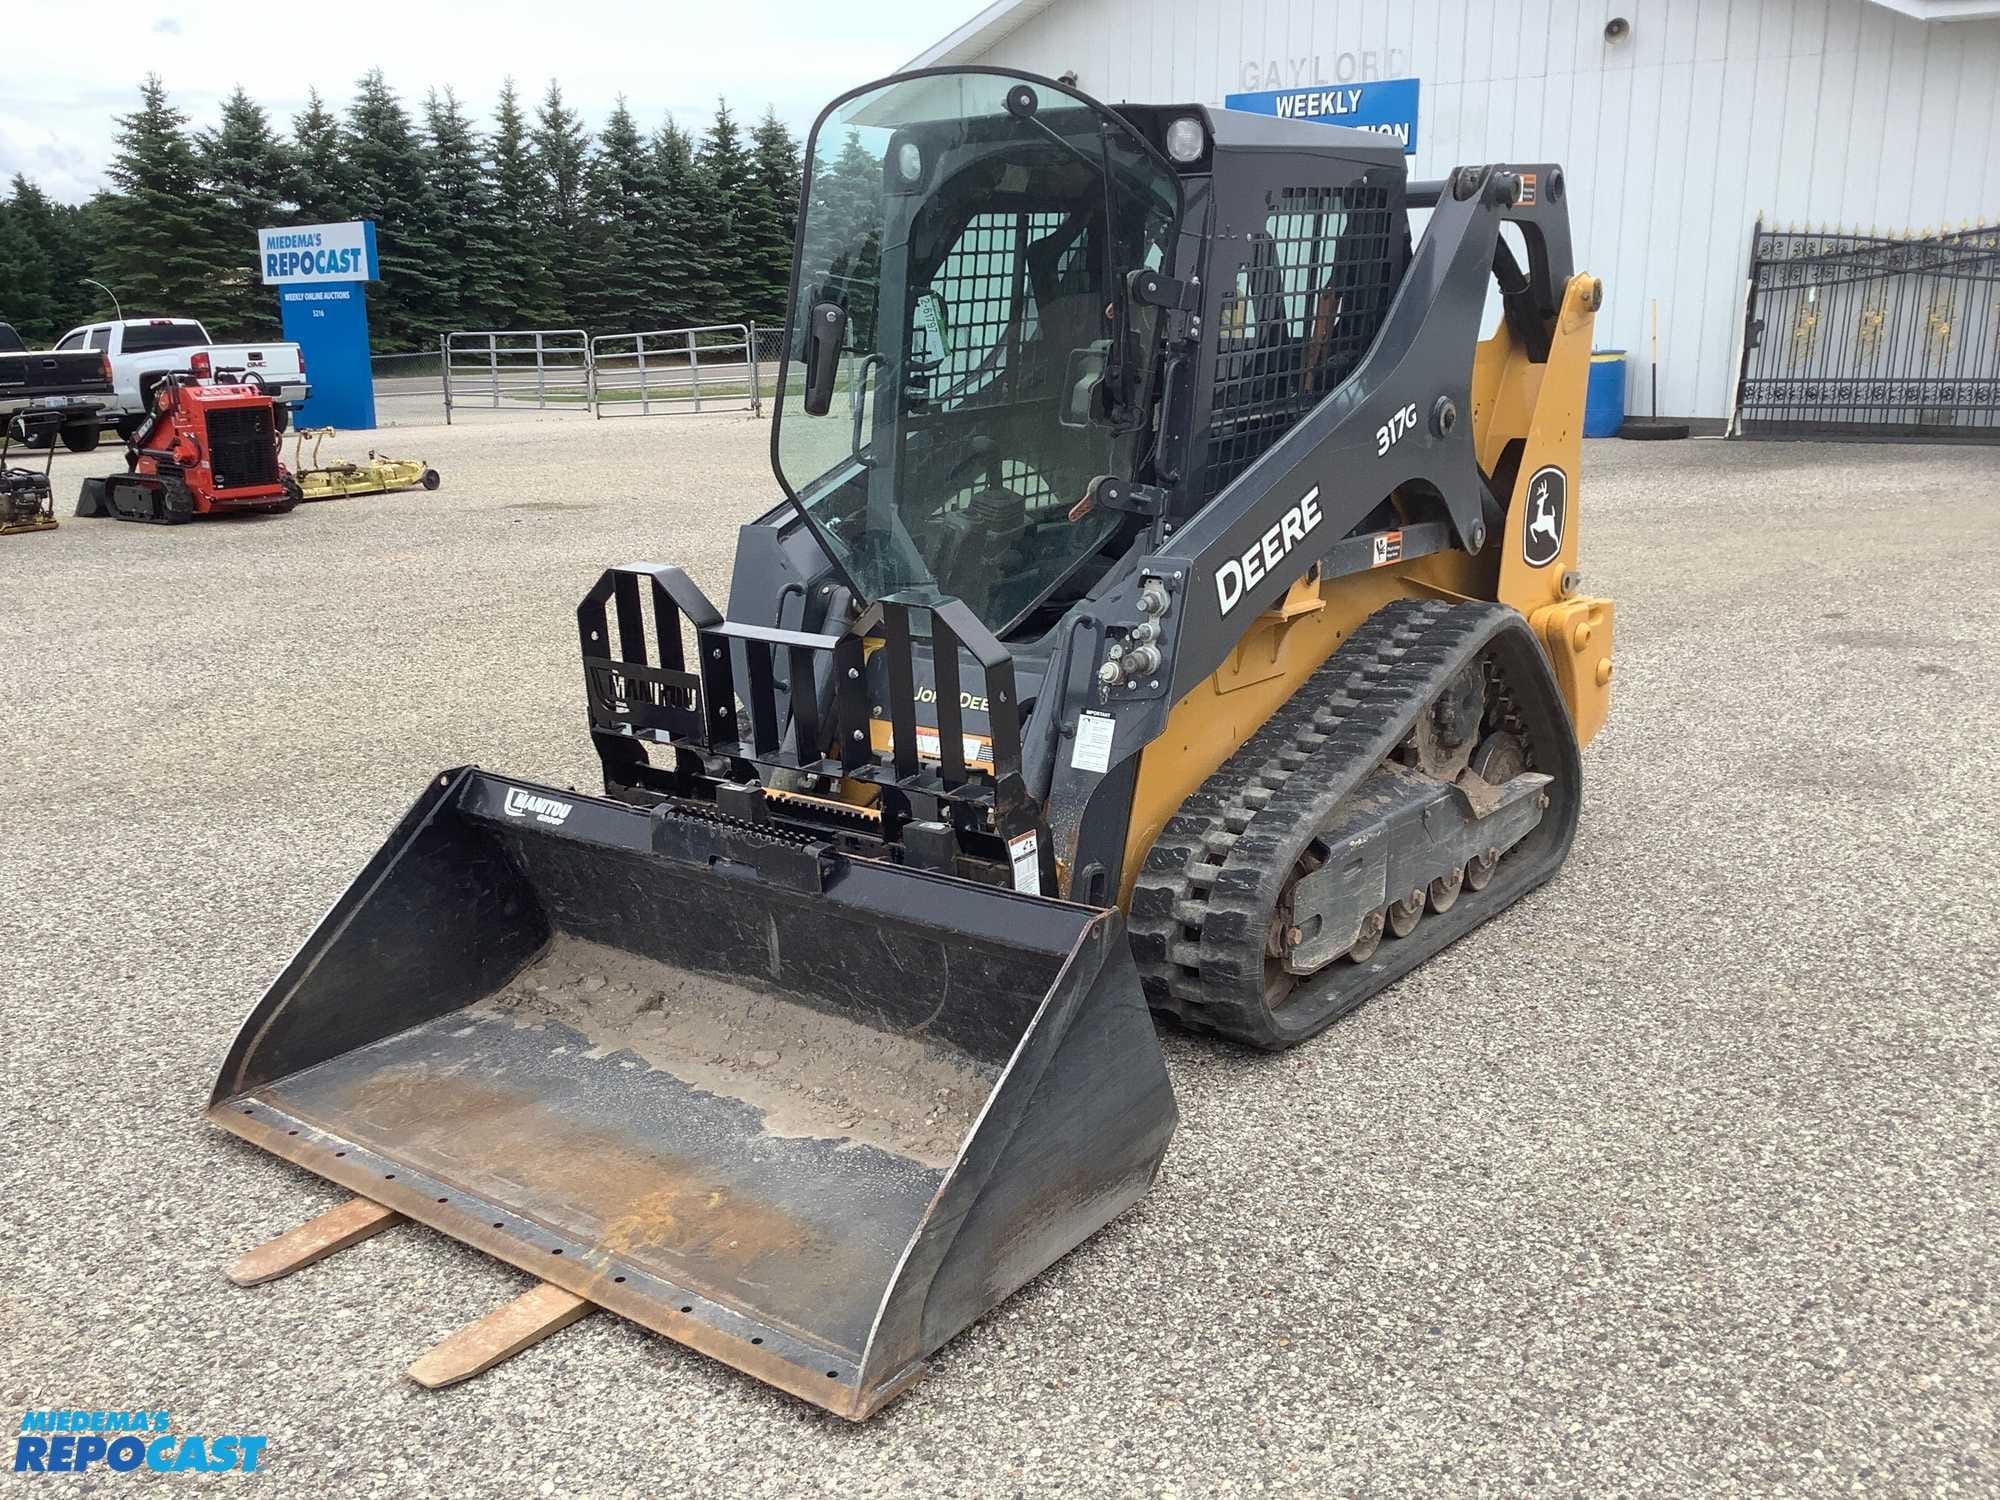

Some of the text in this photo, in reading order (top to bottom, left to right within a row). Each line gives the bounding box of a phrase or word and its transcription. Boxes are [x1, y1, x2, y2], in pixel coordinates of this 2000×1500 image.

[1276, 90, 1362, 118] WEEKLY
[266, 233, 322, 250] MIEDEMA'S
[266, 247, 361, 277] REPOCAST
[284, 293, 304, 301] WEEKLY
[323, 291, 350, 300] AUCTIONS
[247, 361, 267, 369] GMC
[1375, 402, 1417, 457] 317G
[1214, 485, 1323, 616] DEERE
[960, 692, 989, 712] DEE
